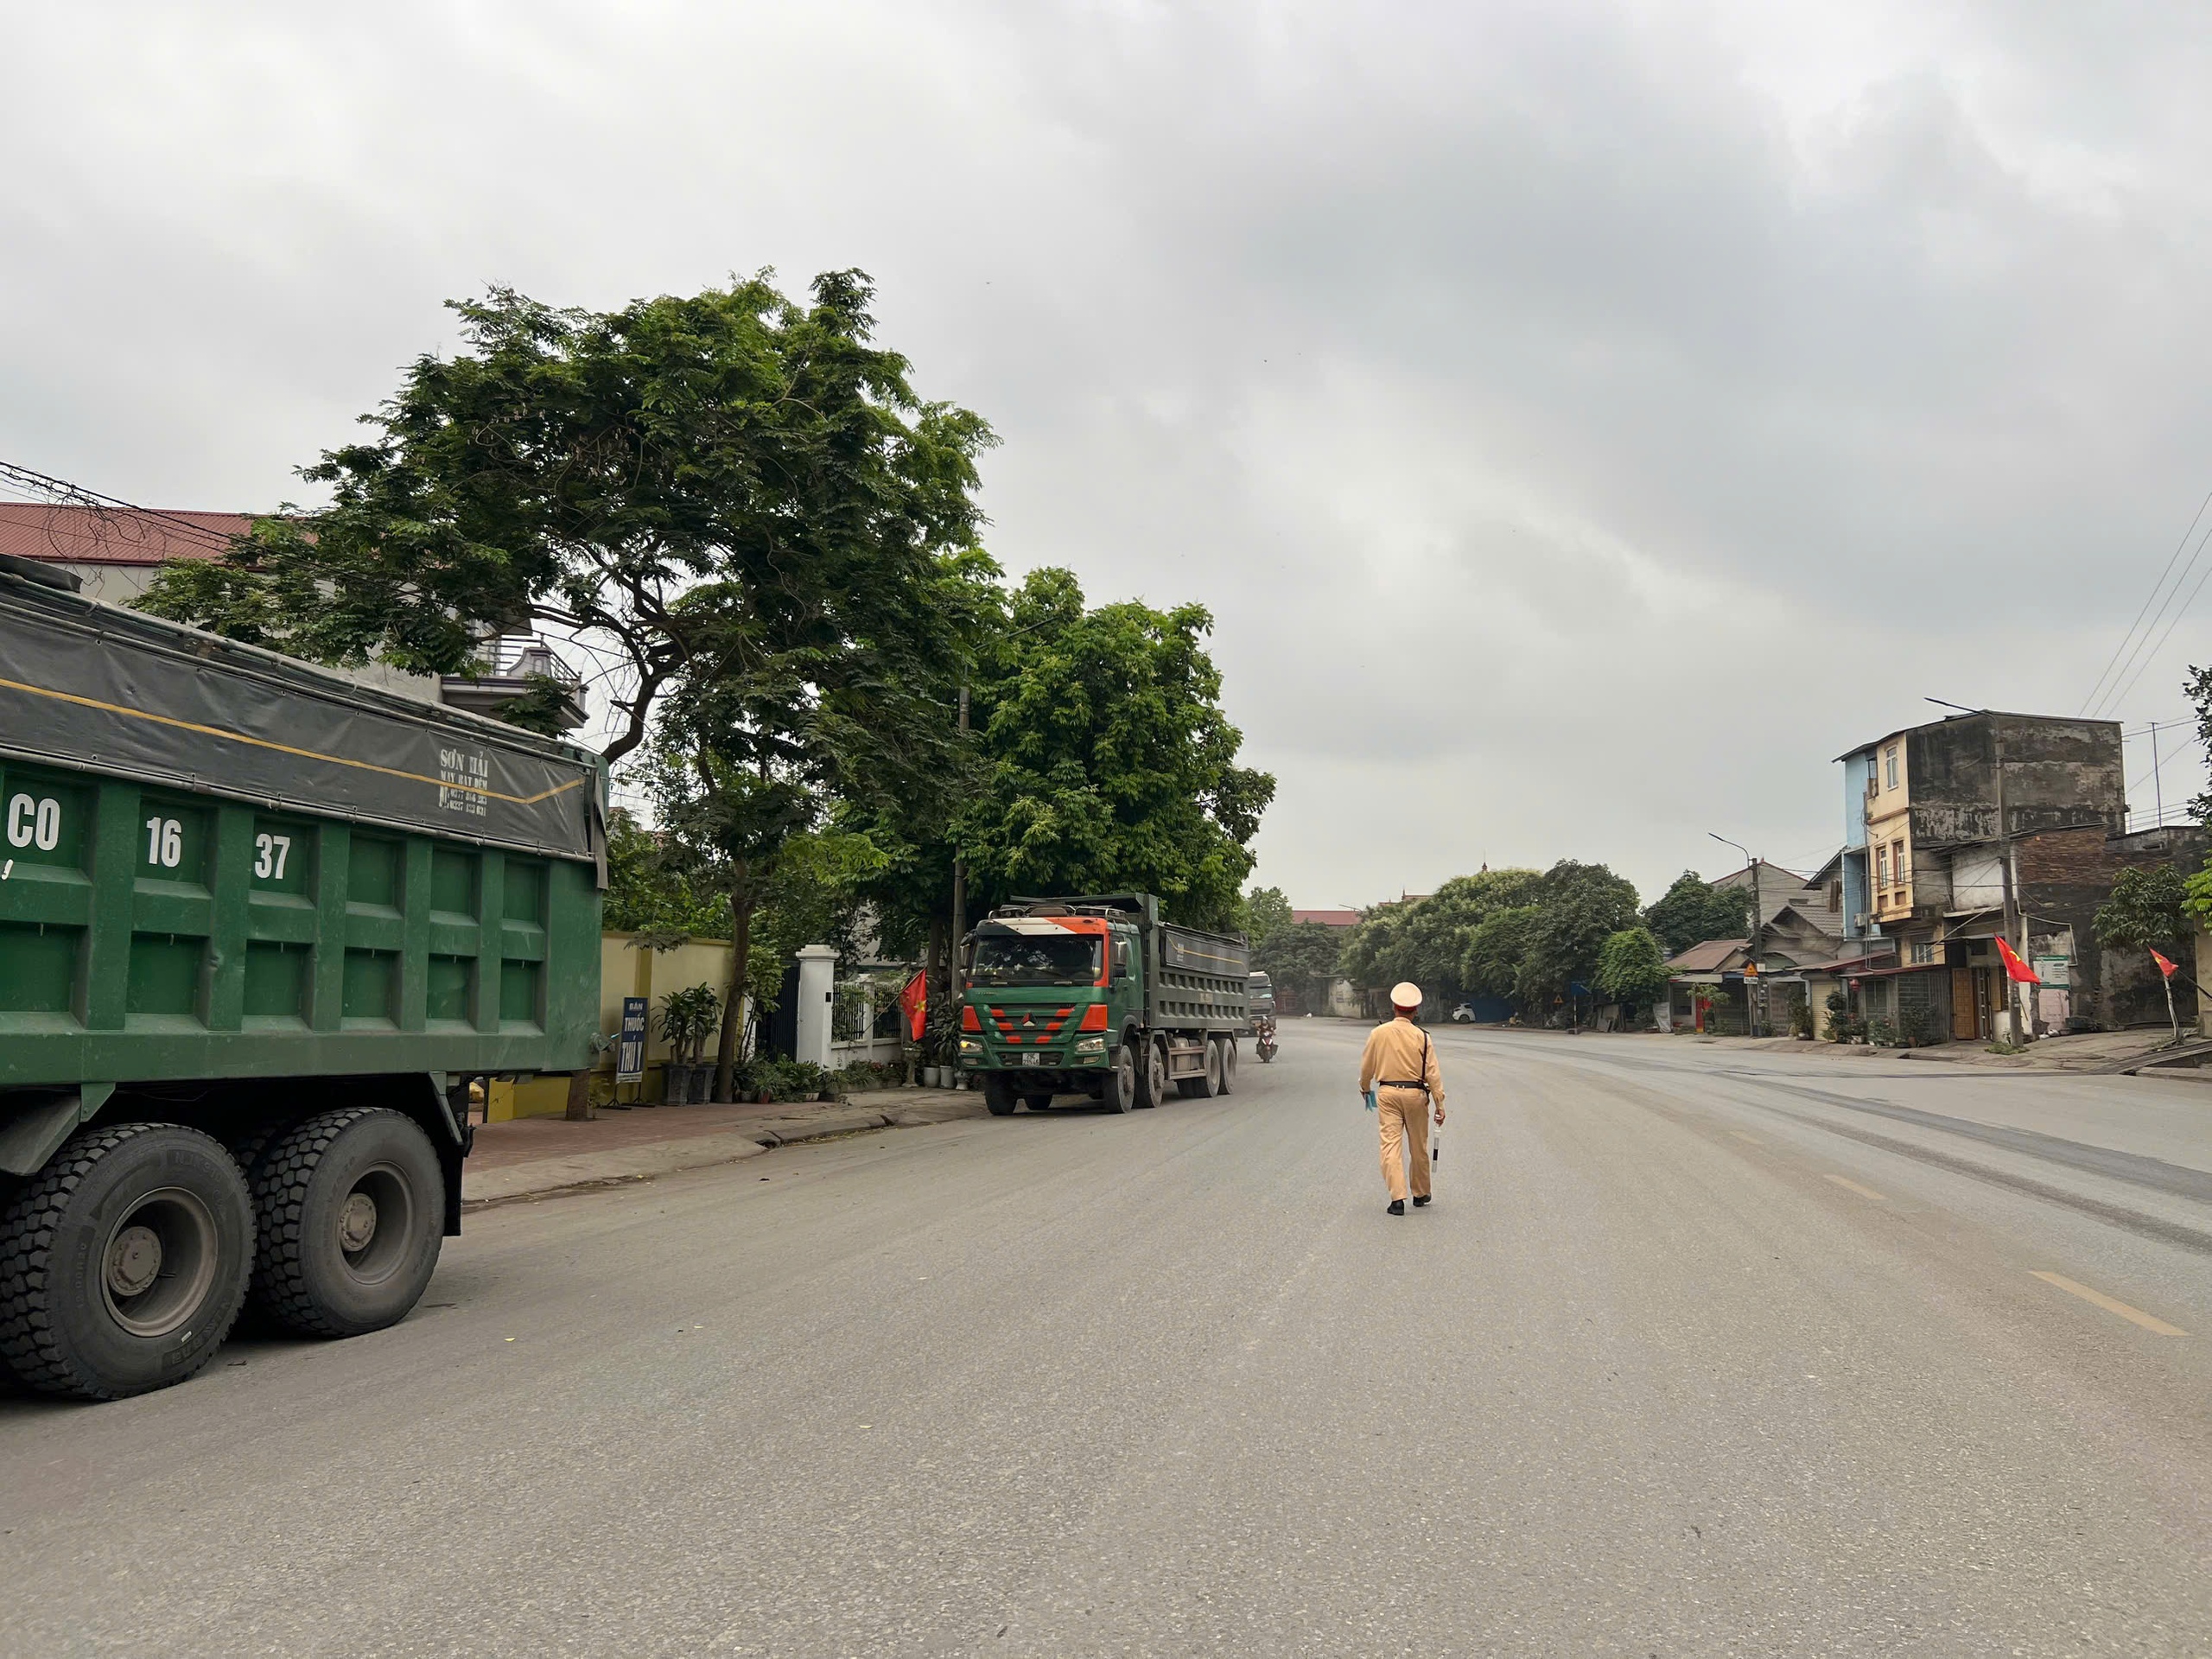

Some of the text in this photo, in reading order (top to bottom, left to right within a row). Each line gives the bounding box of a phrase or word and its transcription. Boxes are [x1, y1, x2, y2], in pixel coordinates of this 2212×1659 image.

[146, 817, 182, 868] 16
[254, 833, 291, 880] 37
[625, 1012, 645, 1033] THUỐC
